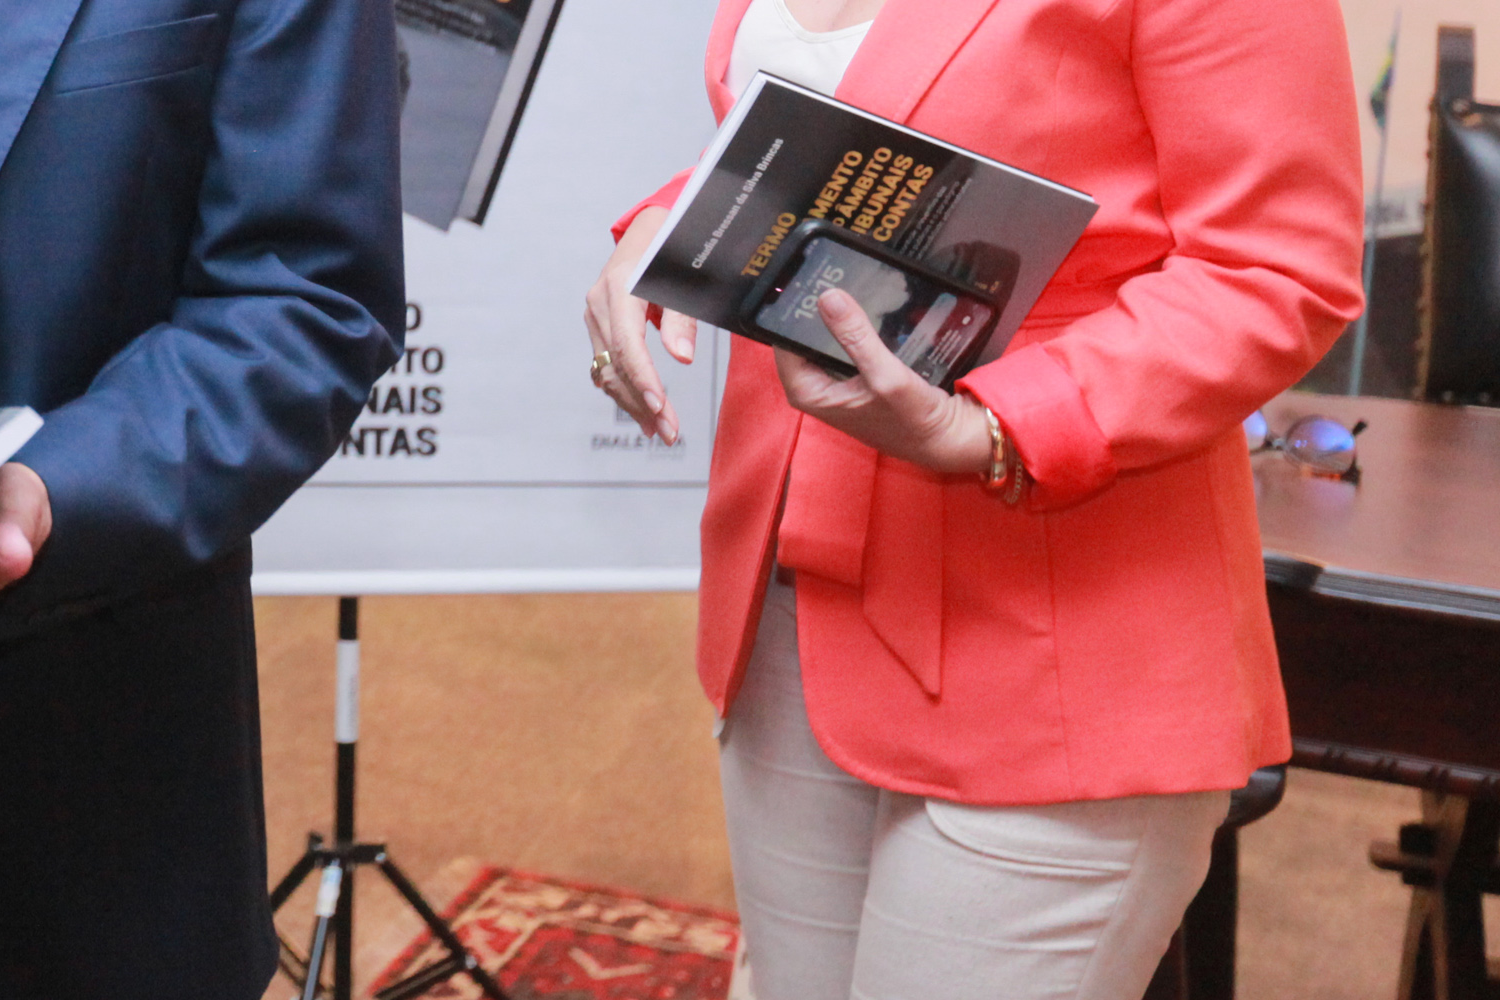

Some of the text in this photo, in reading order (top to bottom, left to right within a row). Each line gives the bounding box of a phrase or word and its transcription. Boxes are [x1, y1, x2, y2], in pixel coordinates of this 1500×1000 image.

[735, 192, 749, 205] da
[742, 170, 763, 193] Silva
[755, 138, 784, 172] Brincas
[803, 150, 864, 222] MENTO
[834, 147, 893, 219] ÂMBITO
[872, 164, 934, 242] CONTAS
[740, 212, 797, 277] TERMO
